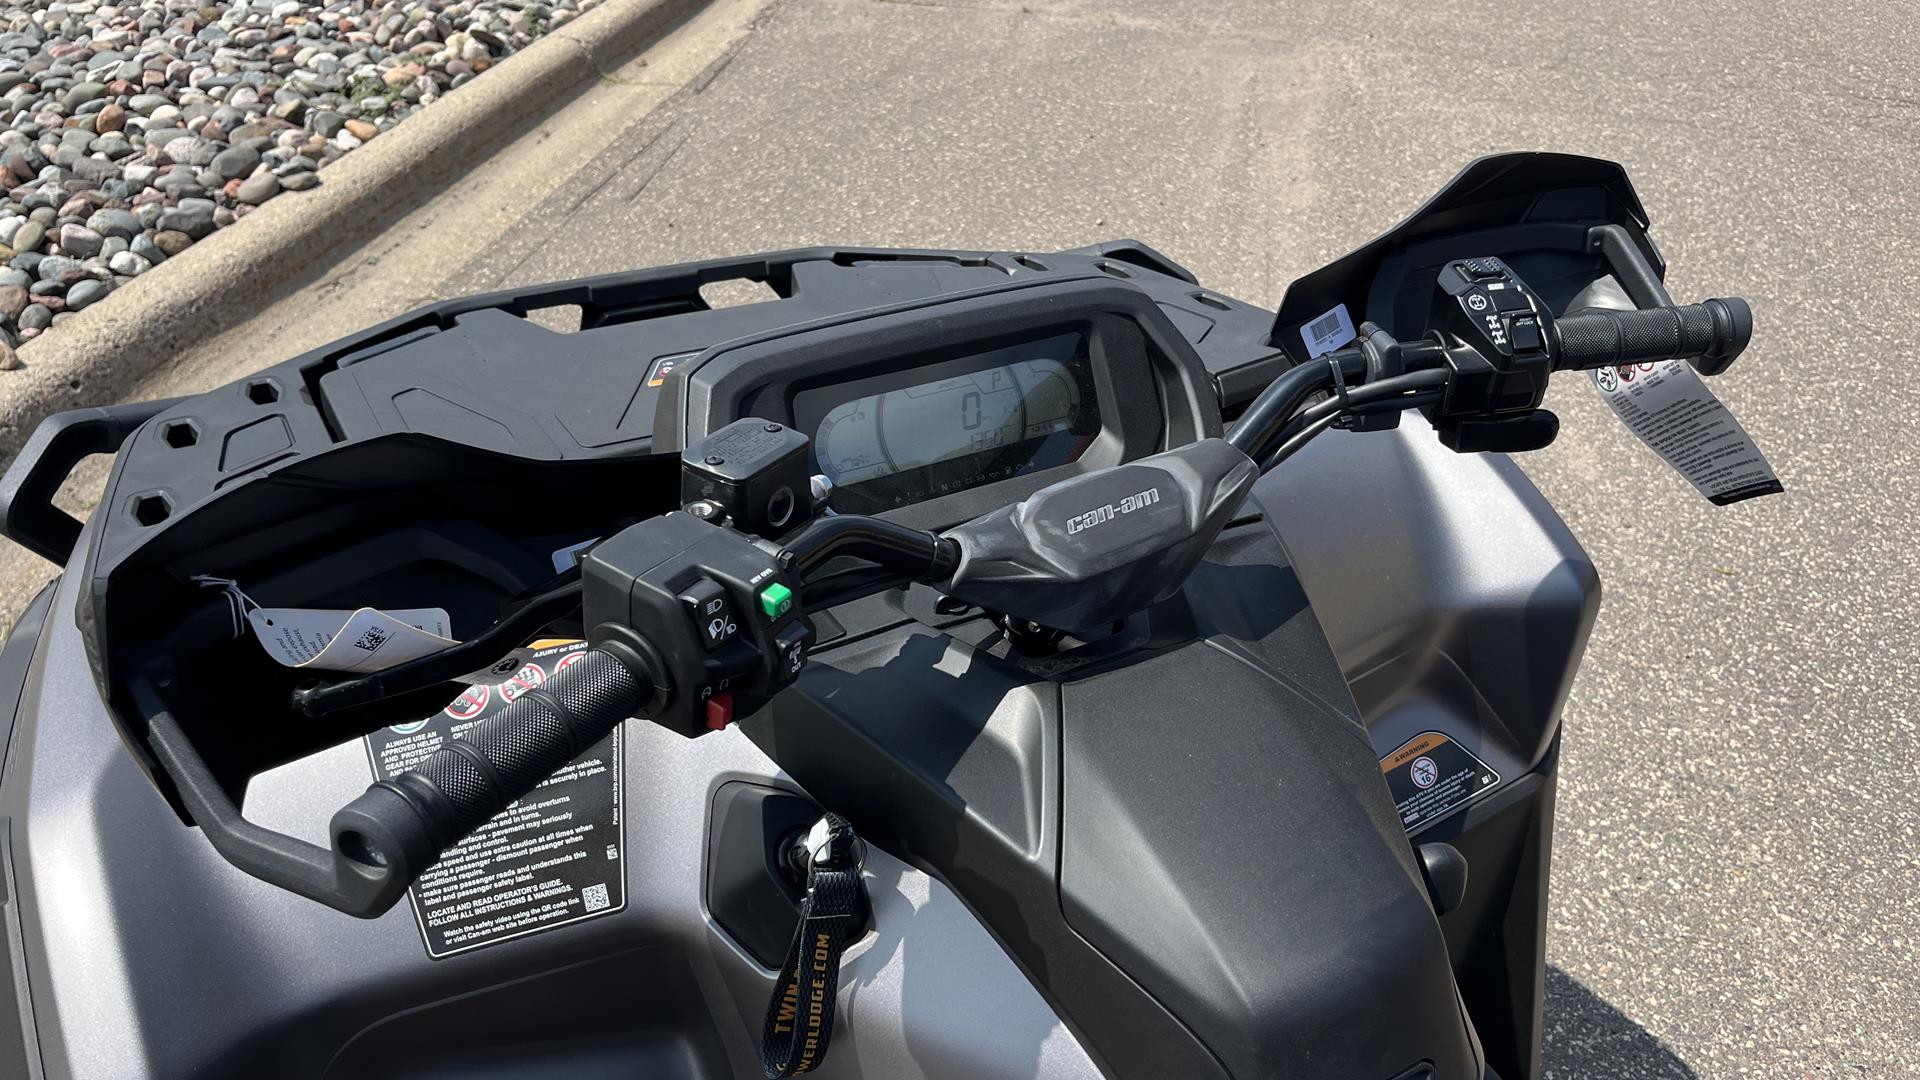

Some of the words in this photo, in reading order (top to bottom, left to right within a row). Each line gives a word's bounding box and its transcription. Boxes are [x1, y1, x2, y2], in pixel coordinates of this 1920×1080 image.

[962, 391, 981, 431] 0
[1065, 487, 1160, 536] can-am
[569, 642, 588, 650] DEAT
[451, 723, 473, 733] NEVER
[380, 745, 417, 758] APPROVED
[417, 736, 443, 747] HELMET
[385, 738, 412, 749] ALWAYS
[412, 734, 426, 742] USE
[426, 731, 437, 739] AN
[384, 755, 399, 764] AND
[1399, 741, 1429, 760] WARNING
[385, 761, 404, 771] GEAR
[405, 757, 419, 766] FOR
[389, 769, 404, 777] AND
[576, 758, 603, 769] vehicle.
[549, 772, 578, 784] securely
[587, 766, 607, 776] place.
[1421, 774, 1431, 784] 16
[518, 803, 537, 813] avoid
[537, 796, 570, 808] overturns
[476, 822, 498, 832] errain
[499, 817, 513, 827] and
[521, 812, 542, 821] turns.
[492, 823, 526, 838] pavement
[526, 820, 541, 828] may
[541, 811, 572, 825] seriously
[443, 856, 464, 867] speed
[465, 852, 478, 861] and
[479, 850, 493, 858] use
[493, 845, 511, 854] extra
[511, 838, 537, 849] caution
[546, 833, 555, 841] all
[555, 829, 575, 838] times
[574, 824, 594, 834] when
[468, 842, 482, 852] and
[482, 836, 509, 848] control.
[420, 869, 449, 881] carrying
[455, 858, 491, 874] passenger
[496, 848, 528, 862] dismount
[528, 839, 564, 855] passenger
[565, 835, 584, 844] when
[421, 875, 458, 889] conditions
[458, 868, 485, 880] require.
[423, 888, 442, 898] make
[442, 884, 459, 893] sure
[460, 874, 495, 890] passenger
[496, 869, 516, 879] reads
[516, 865, 530, 874] and
[530, 854, 573, 870] understands
[573, 851, 587, 860] this
[424, 896, 442, 906] label
[442, 892, 456, 901] and
[456, 883, 493, 899] passenger
[493, 878, 515, 888] safety
[515, 872, 535, 883] label.
[427, 905, 456, 920] LOCATE
[456, 901, 472, 912] AND
[472, 896, 493, 907] READ
[493, 885, 539, 901] OPERATOR'S
[539, 878, 564, 890] GUIDE.
[428, 913, 459, 927] FOLLOW
[460, 909, 474, 920] ALL
[474, 895, 526, 915] INSTRUCTIONS
[533, 884, 574, 900] WARNINGS.
[443, 927, 464, 938] Watch
[464, 925, 475, 933] the
[475, 919, 494, 930] safety
[494, 915, 512, 924] video
[512, 911, 530, 920] using
[530, 907, 540, 915] the
[541, 904, 552, 912] QR
[552, 900, 568, 909] code
[567, 896, 580, 906] link
[453, 934, 467, 943] visit
[467, 928, 492, 939] Can-am
[491, 924, 505, 933] web
[506, 921, 518, 929] site
[518, 916, 538, 926] before
[539, 908, 570, 921] operation.
